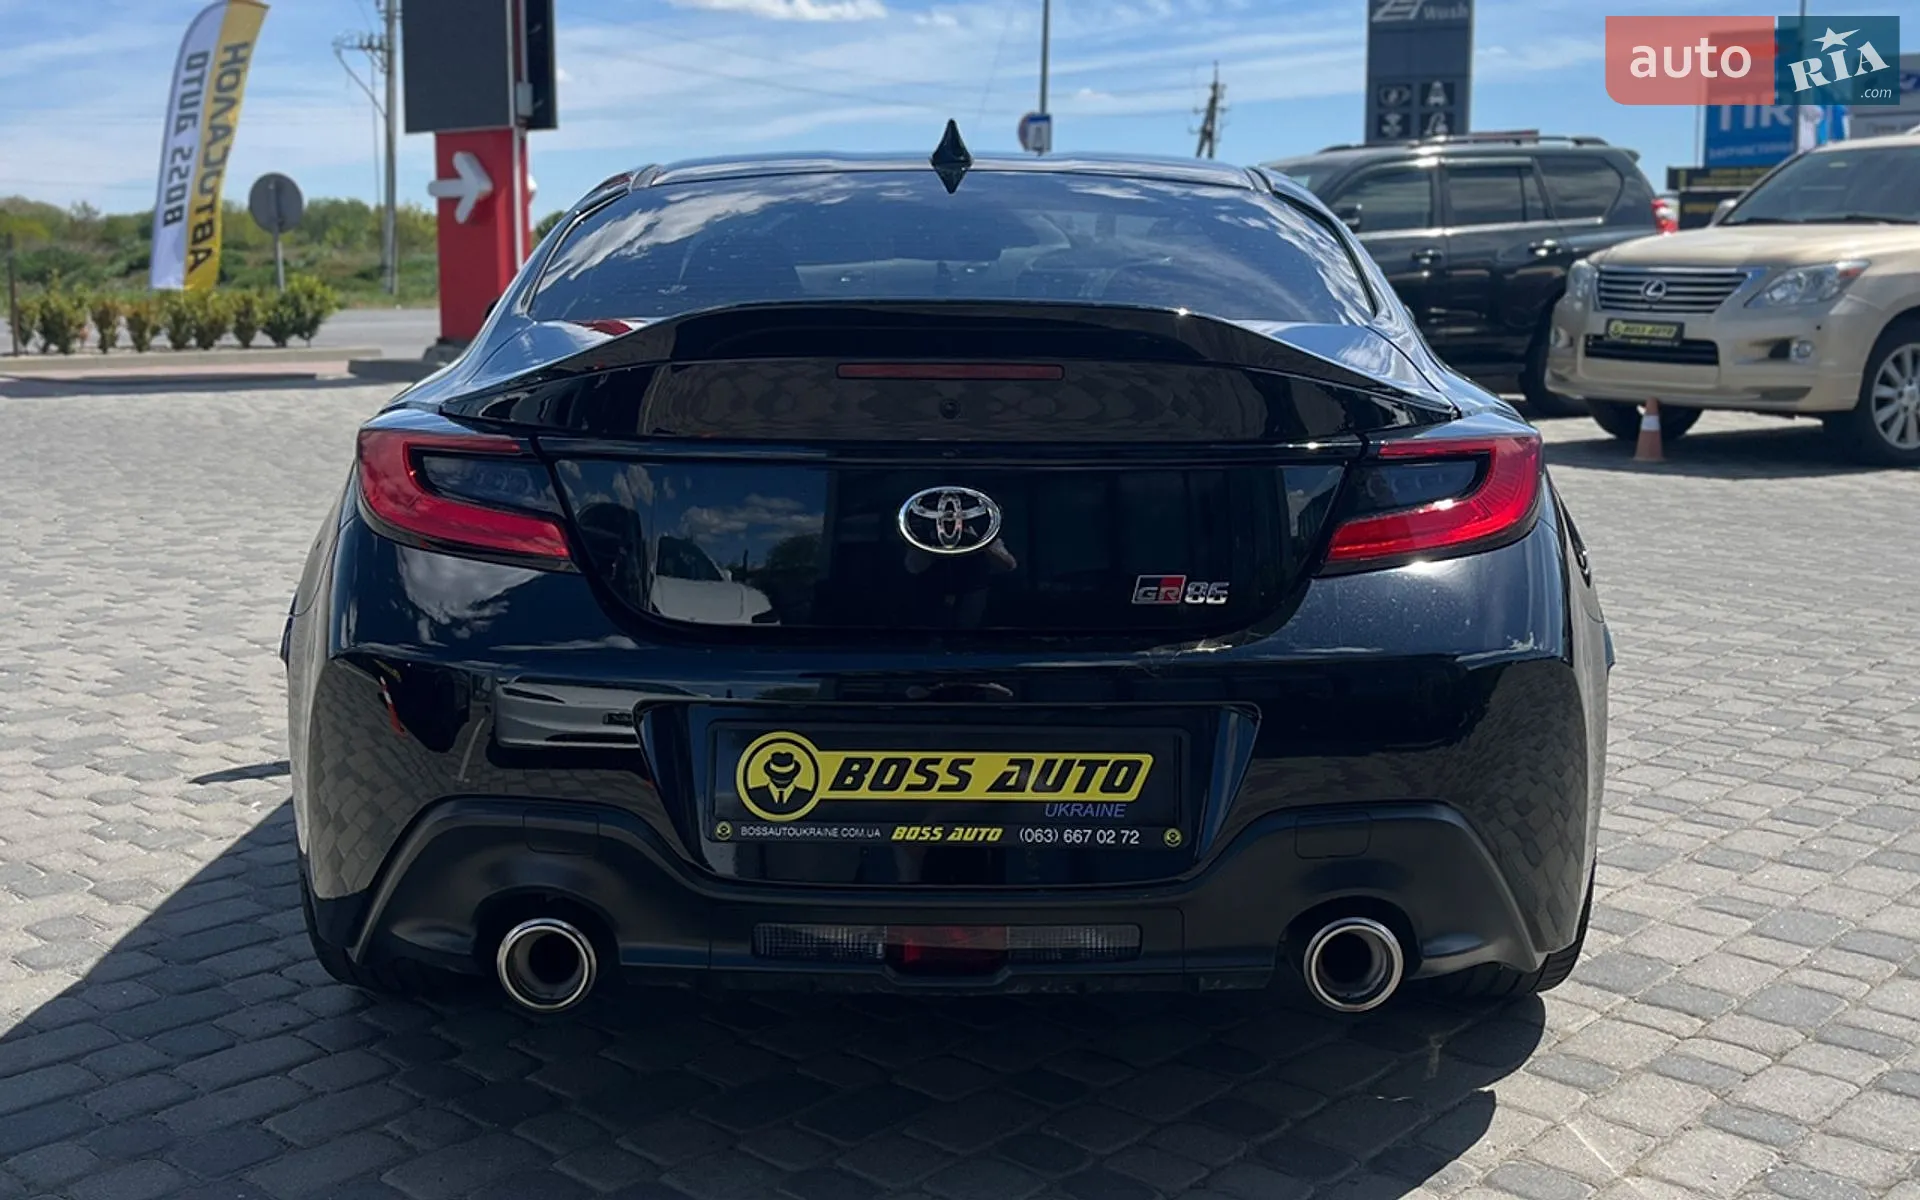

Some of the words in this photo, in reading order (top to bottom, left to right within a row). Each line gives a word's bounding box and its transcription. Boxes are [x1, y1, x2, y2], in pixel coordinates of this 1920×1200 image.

[1136, 586, 1181, 604] GR
[1185, 581, 1230, 604] 86
[828, 757, 976, 792] BOSS
[985, 758, 1144, 793] AUTO
[1044, 803, 1127, 818] UKRAINE
[891, 826, 943, 841] BOSS
[946, 827, 1003, 841] AUTO
[1019, 828, 1058, 843] (063)
[1063, 829, 1092, 843] 667
[1096, 830, 1116, 844] 02
[1120, 830, 1140, 844] 72
